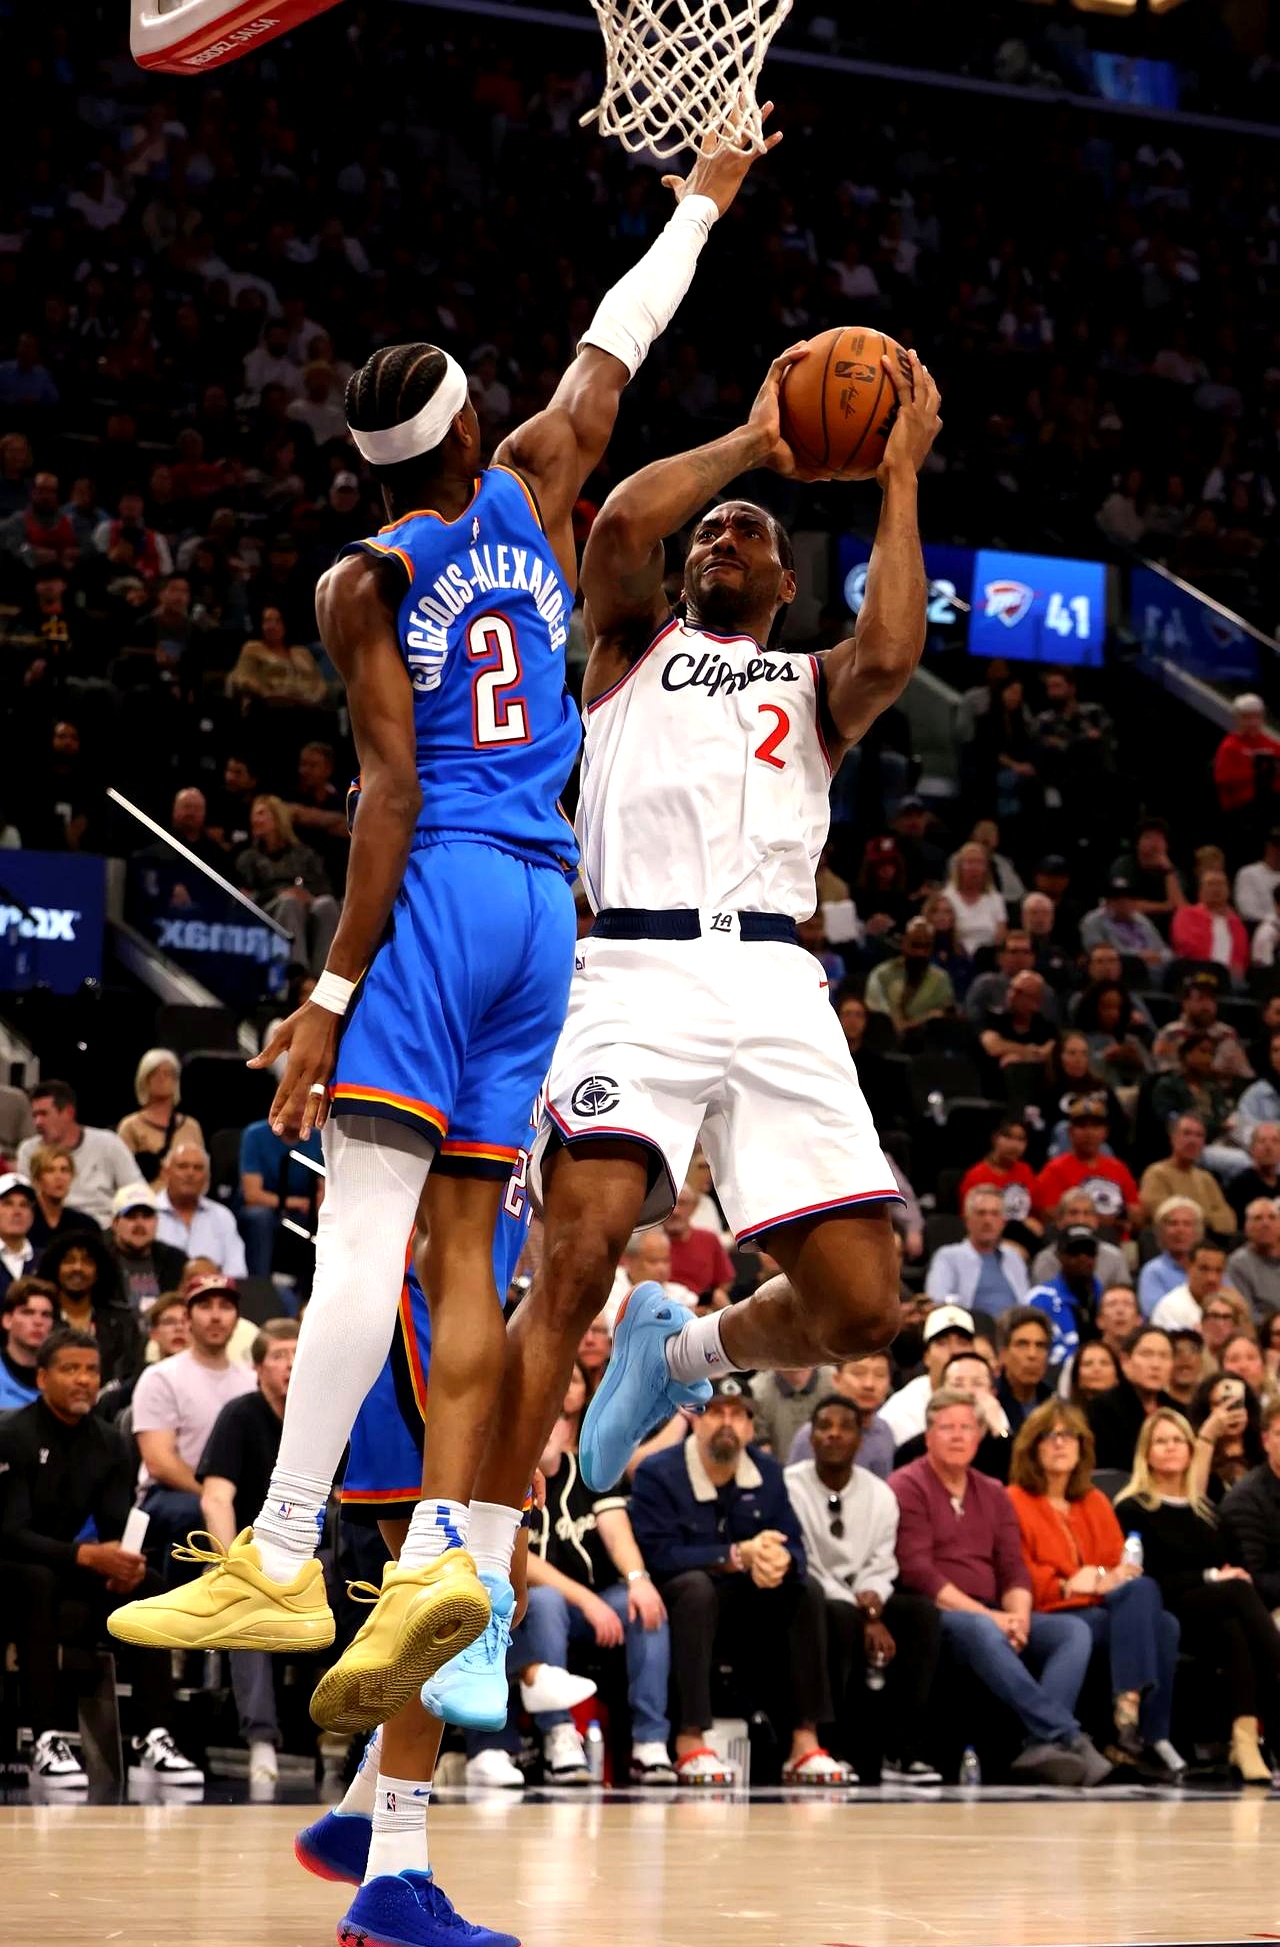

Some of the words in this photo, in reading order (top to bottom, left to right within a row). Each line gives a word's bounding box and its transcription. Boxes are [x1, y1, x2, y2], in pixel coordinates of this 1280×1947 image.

[229, 18, 280, 41] SALSA
[406, 544, 568, 692] GILGEOUS-ALEXANDER
[1045, 593, 1090, 638] 41
[465, 609, 531, 749] 2
[661, 653, 800, 697] Clippers
[754, 703, 790, 770] 2
